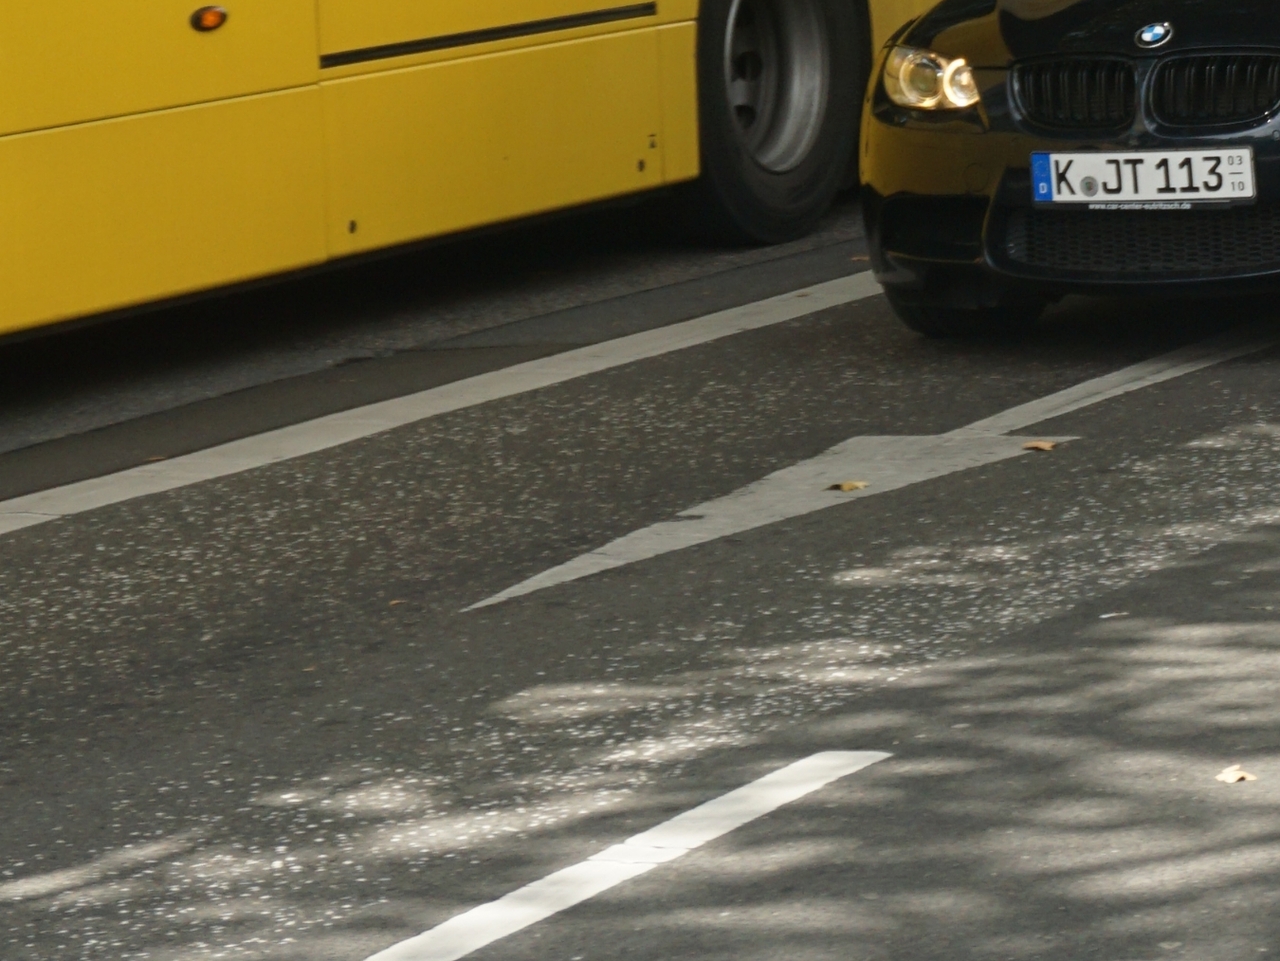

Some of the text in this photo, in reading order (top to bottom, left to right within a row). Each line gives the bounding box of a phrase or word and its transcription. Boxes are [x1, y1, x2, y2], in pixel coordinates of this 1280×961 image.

[1227, 155, 1243, 166] 03
[1054, 156, 1223, 195] K JT 113
[1038, 183, 1048, 194] D
[1230, 181, 1245, 192] 10
